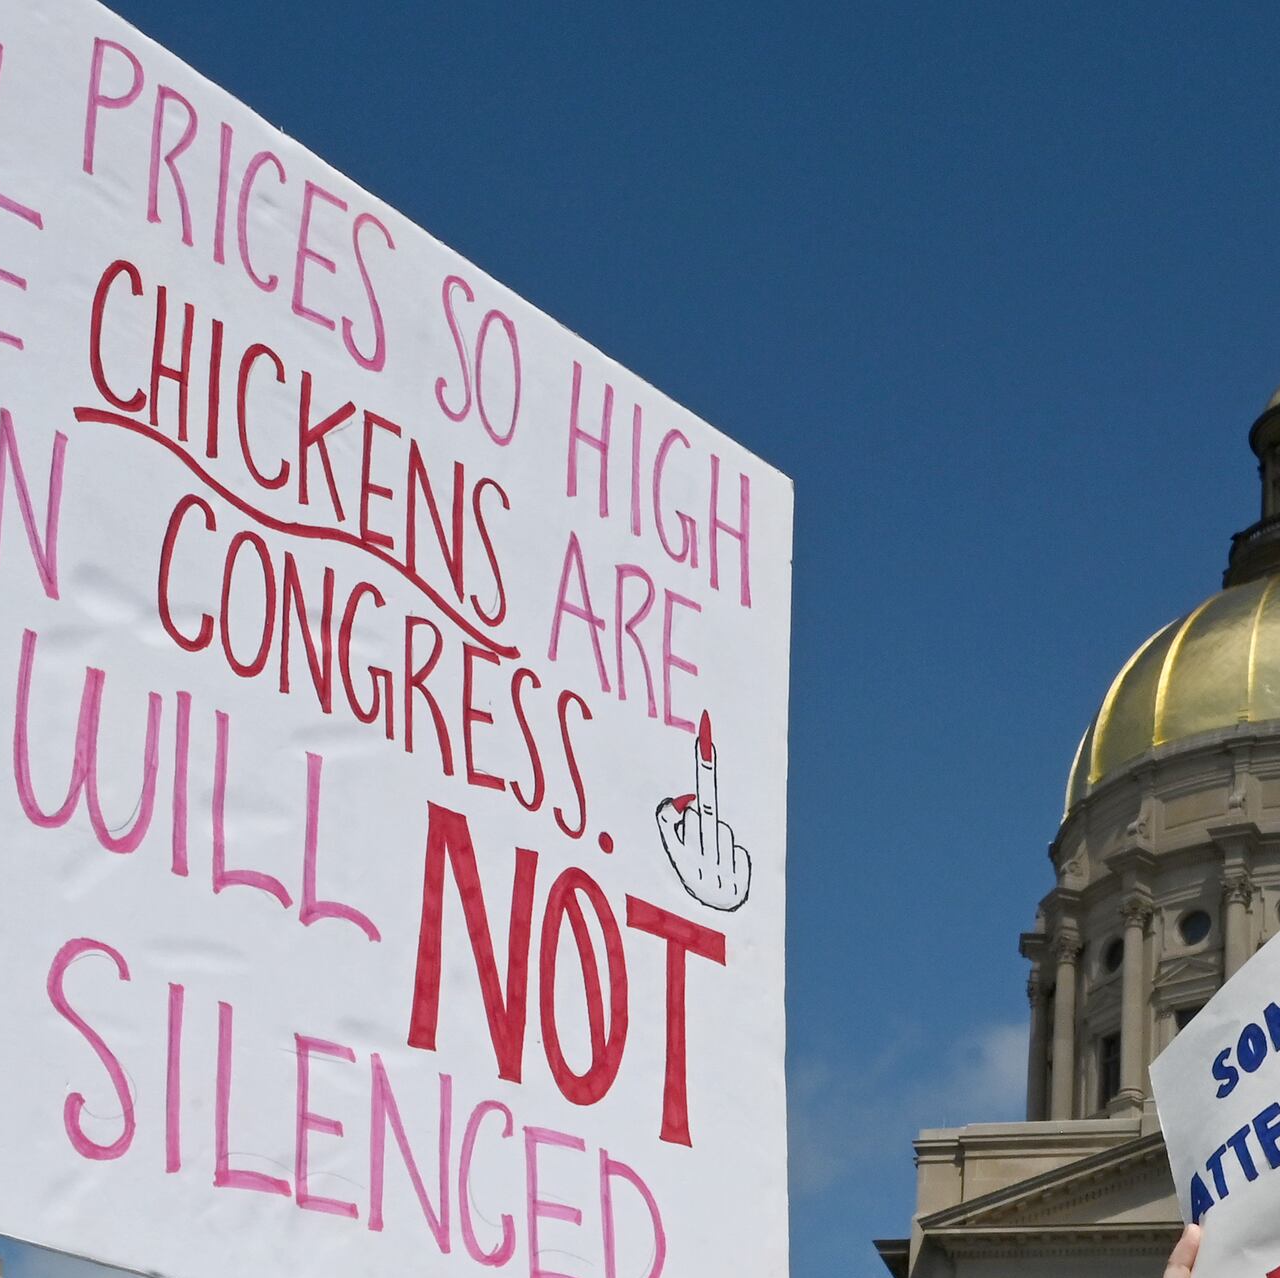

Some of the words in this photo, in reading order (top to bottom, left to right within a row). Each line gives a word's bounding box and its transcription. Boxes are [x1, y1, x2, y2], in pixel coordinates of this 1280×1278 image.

[84, 36, 393, 372] PRICES
[435, 276, 520, 446] SO
[565, 361, 752, 608] HIGH
[87, 259, 514, 629] CHICKENS
[547, 530, 702, 735] ARE
[12, 628, 380, 942] WILL
[407, 800, 726, 1147] NOT
[157, 494, 615, 855] CONGRESS.
